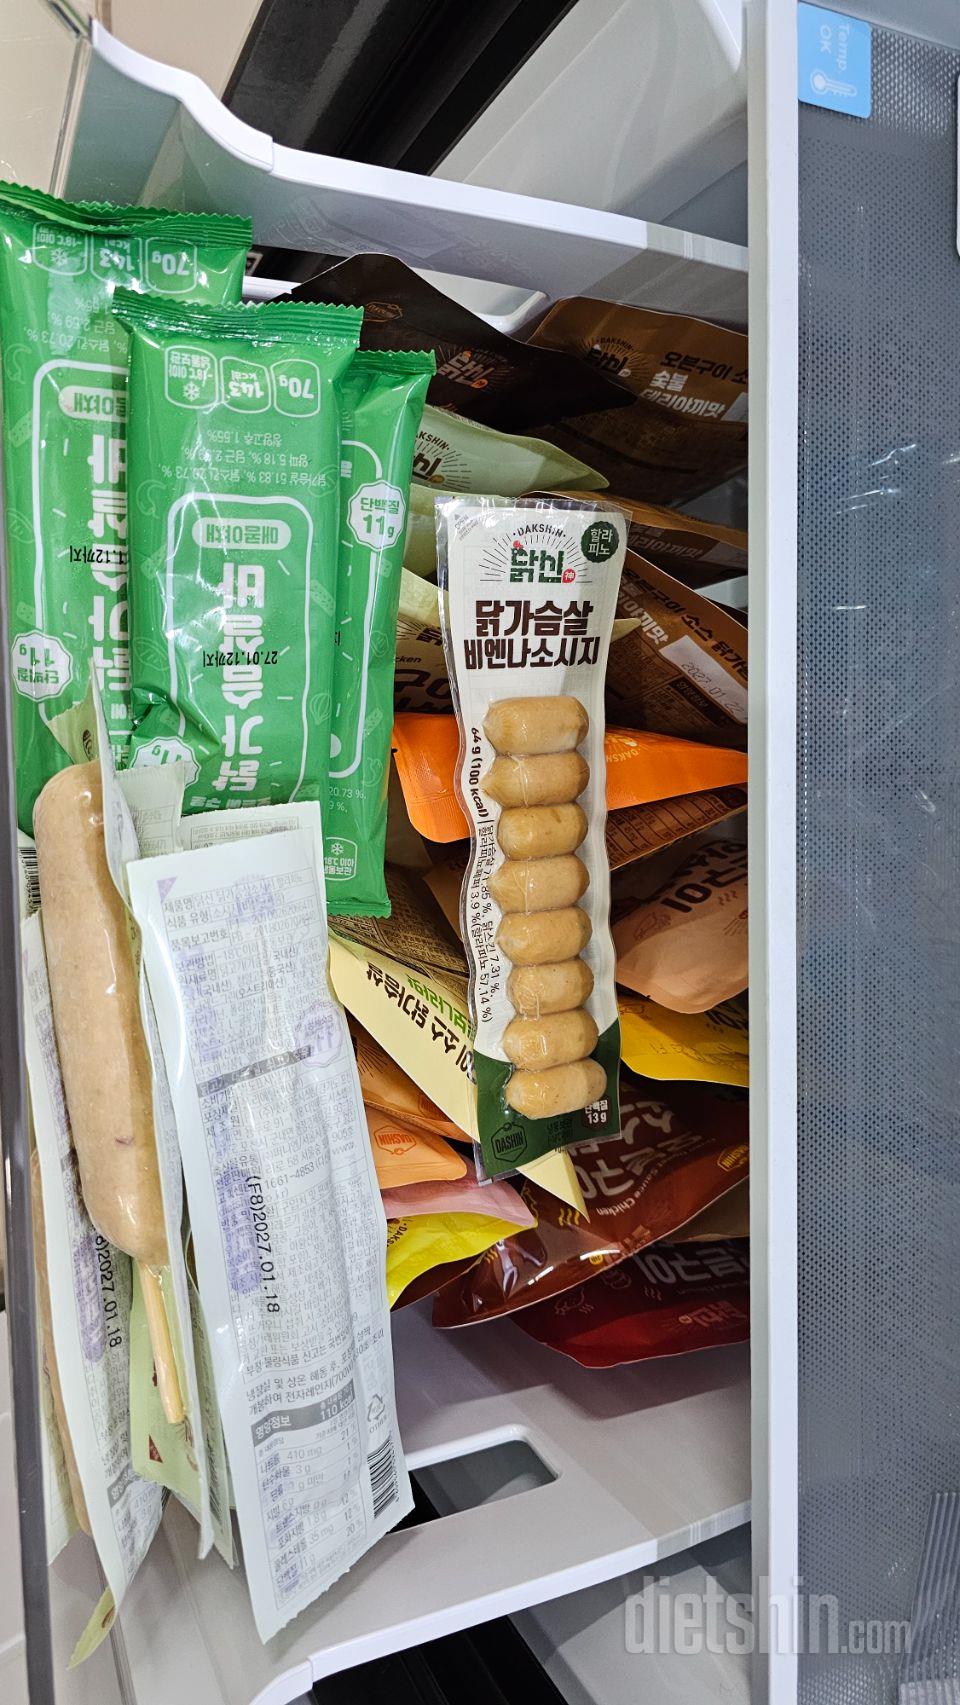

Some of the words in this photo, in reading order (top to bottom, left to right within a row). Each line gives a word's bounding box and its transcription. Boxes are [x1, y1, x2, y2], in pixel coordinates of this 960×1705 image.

[820, 25, 833, 54] OK
[837, 24, 851, 70] Temp
[149, 250, 191, 276] 70g
[660, 350, 734, 380] 오븐구이
[228, 380, 264, 398] 143
[278, 374, 315, 399] 70g
[648, 369, 689, 393] 숯불
[415, 430, 450, 452] KSHIN
[224, 450, 247, 464] 당근
[263, 452, 287, 467] 5.18
[289, 454, 309, 468] 양파
[258, 470, 288, 486] 51.83
[359, 496, 402, 517] 단백질
[362, 513, 397, 539] 11g
[516, 523, 566, 540] DAKSHIN
[590, 527, 615, 543] 할라
[70, 545, 124, 567] 1.12까지
[587, 542, 612, 557] 피노
[475, 600, 594, 637] 닭가슴살
[200, 648, 278, 670] 27.01.12까지
[463, 636, 602, 671] 비엔나소시지
[470, 727, 481, 743] 64
[470, 745, 482, 756] g
[467, 757, 484, 786] (100
[470, 787, 491, 819] kcal)
[470, 890, 482, 910] 3.9
[488, 955, 501, 979] 7.31
[365, 960, 430, 1029] 닭가슴살
[433, 1017, 460, 1055] 소스
[374, 1131, 414, 1147] DASHIN
[495, 1130, 524, 1156] DASHIN
[595, 1197, 637, 1219] Chicken
[245, 1174, 281, 1313] (F8)2027.01.18
[92, 1225, 123, 1348] 8)2027.01.18
[255, 1414, 292, 1440] 영양정보
